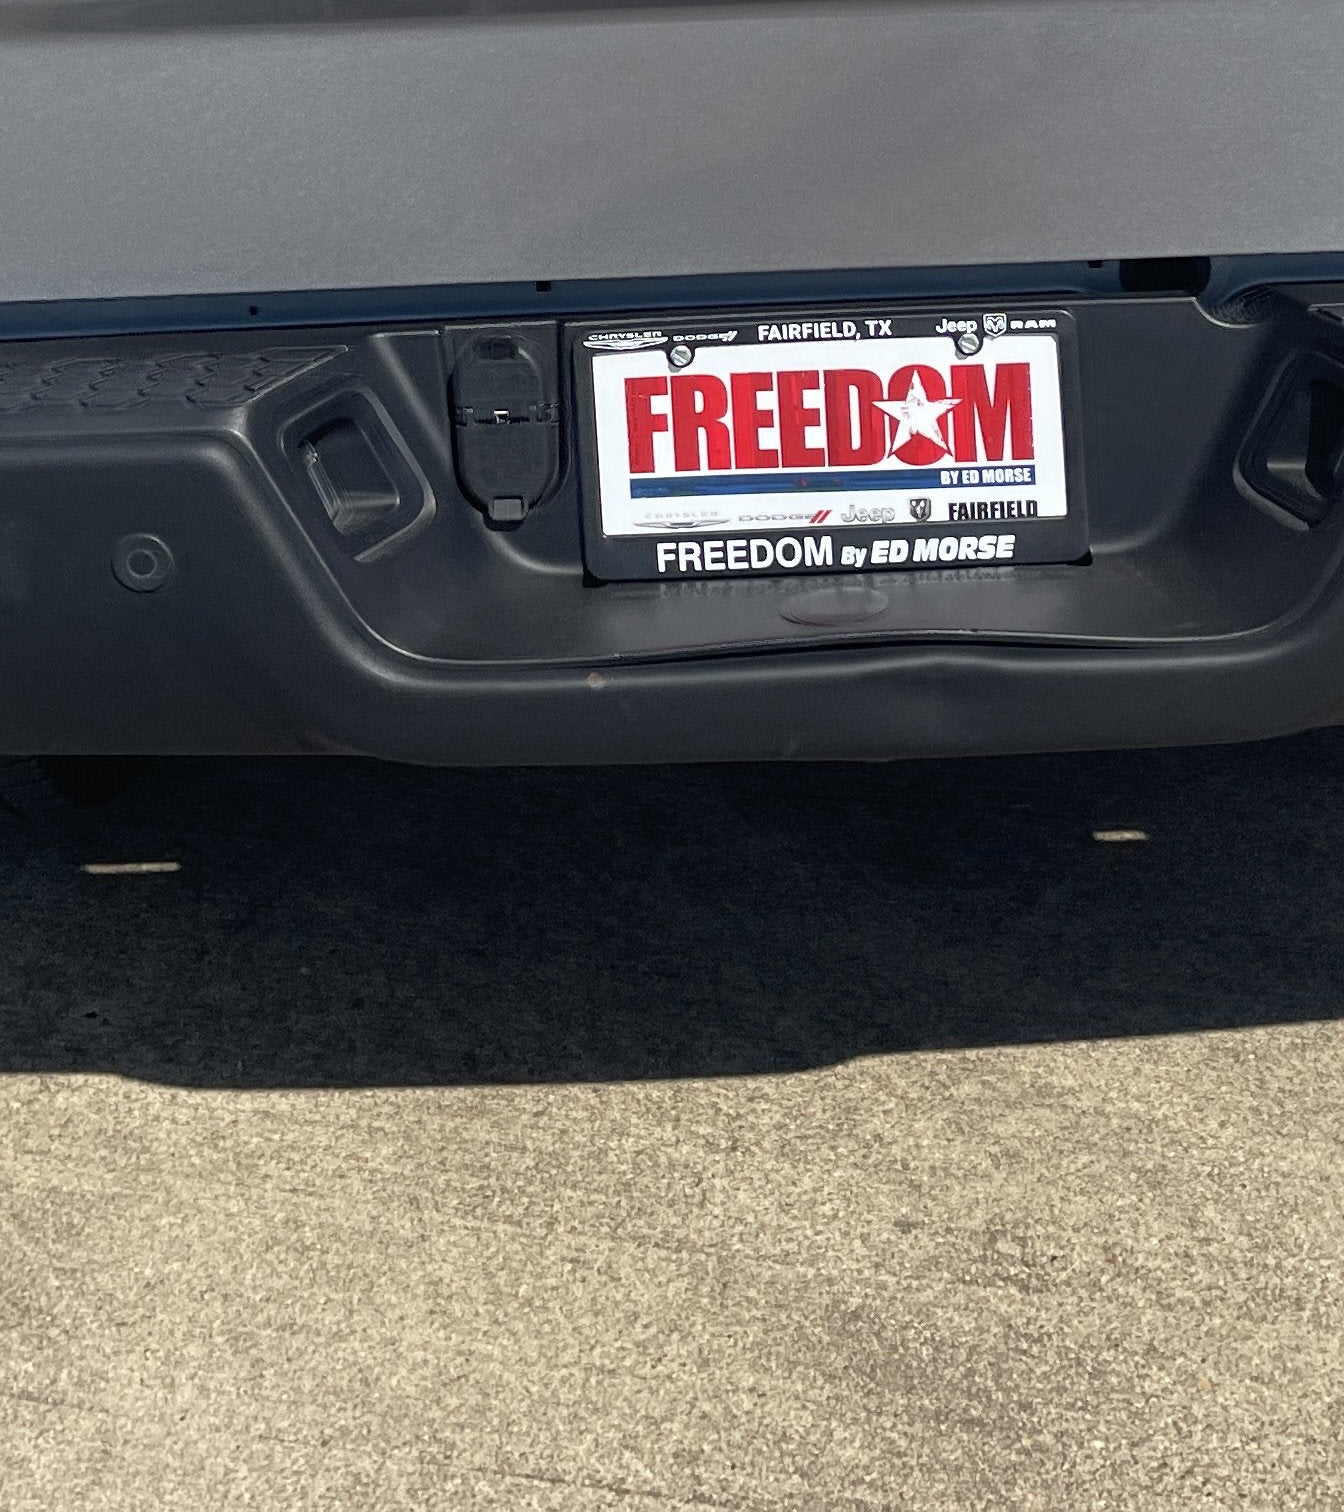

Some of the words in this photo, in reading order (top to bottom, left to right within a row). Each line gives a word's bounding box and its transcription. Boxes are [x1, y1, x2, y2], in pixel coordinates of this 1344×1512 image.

[757, 321, 861, 341] FAIRFIELD,
[864, 319, 892, 337] TX
[935, 318, 977, 334] Jeep
[1009, 319, 1056, 330] RAM
[588, 331, 662, 341] CHRYSLER
[624, 362, 1035, 473] FREEDOM
[940, 470, 960, 485] BY
[962, 470, 980, 484] ED
[982, 467, 1031, 483] MORSE
[841, 504, 896, 524] Jeep
[948, 500, 1038, 521] FAIRFIELD
[656, 535, 833, 573] FREEDOM
[870, 539, 909, 564] ED
[912, 534, 1016, 562] MORSE
